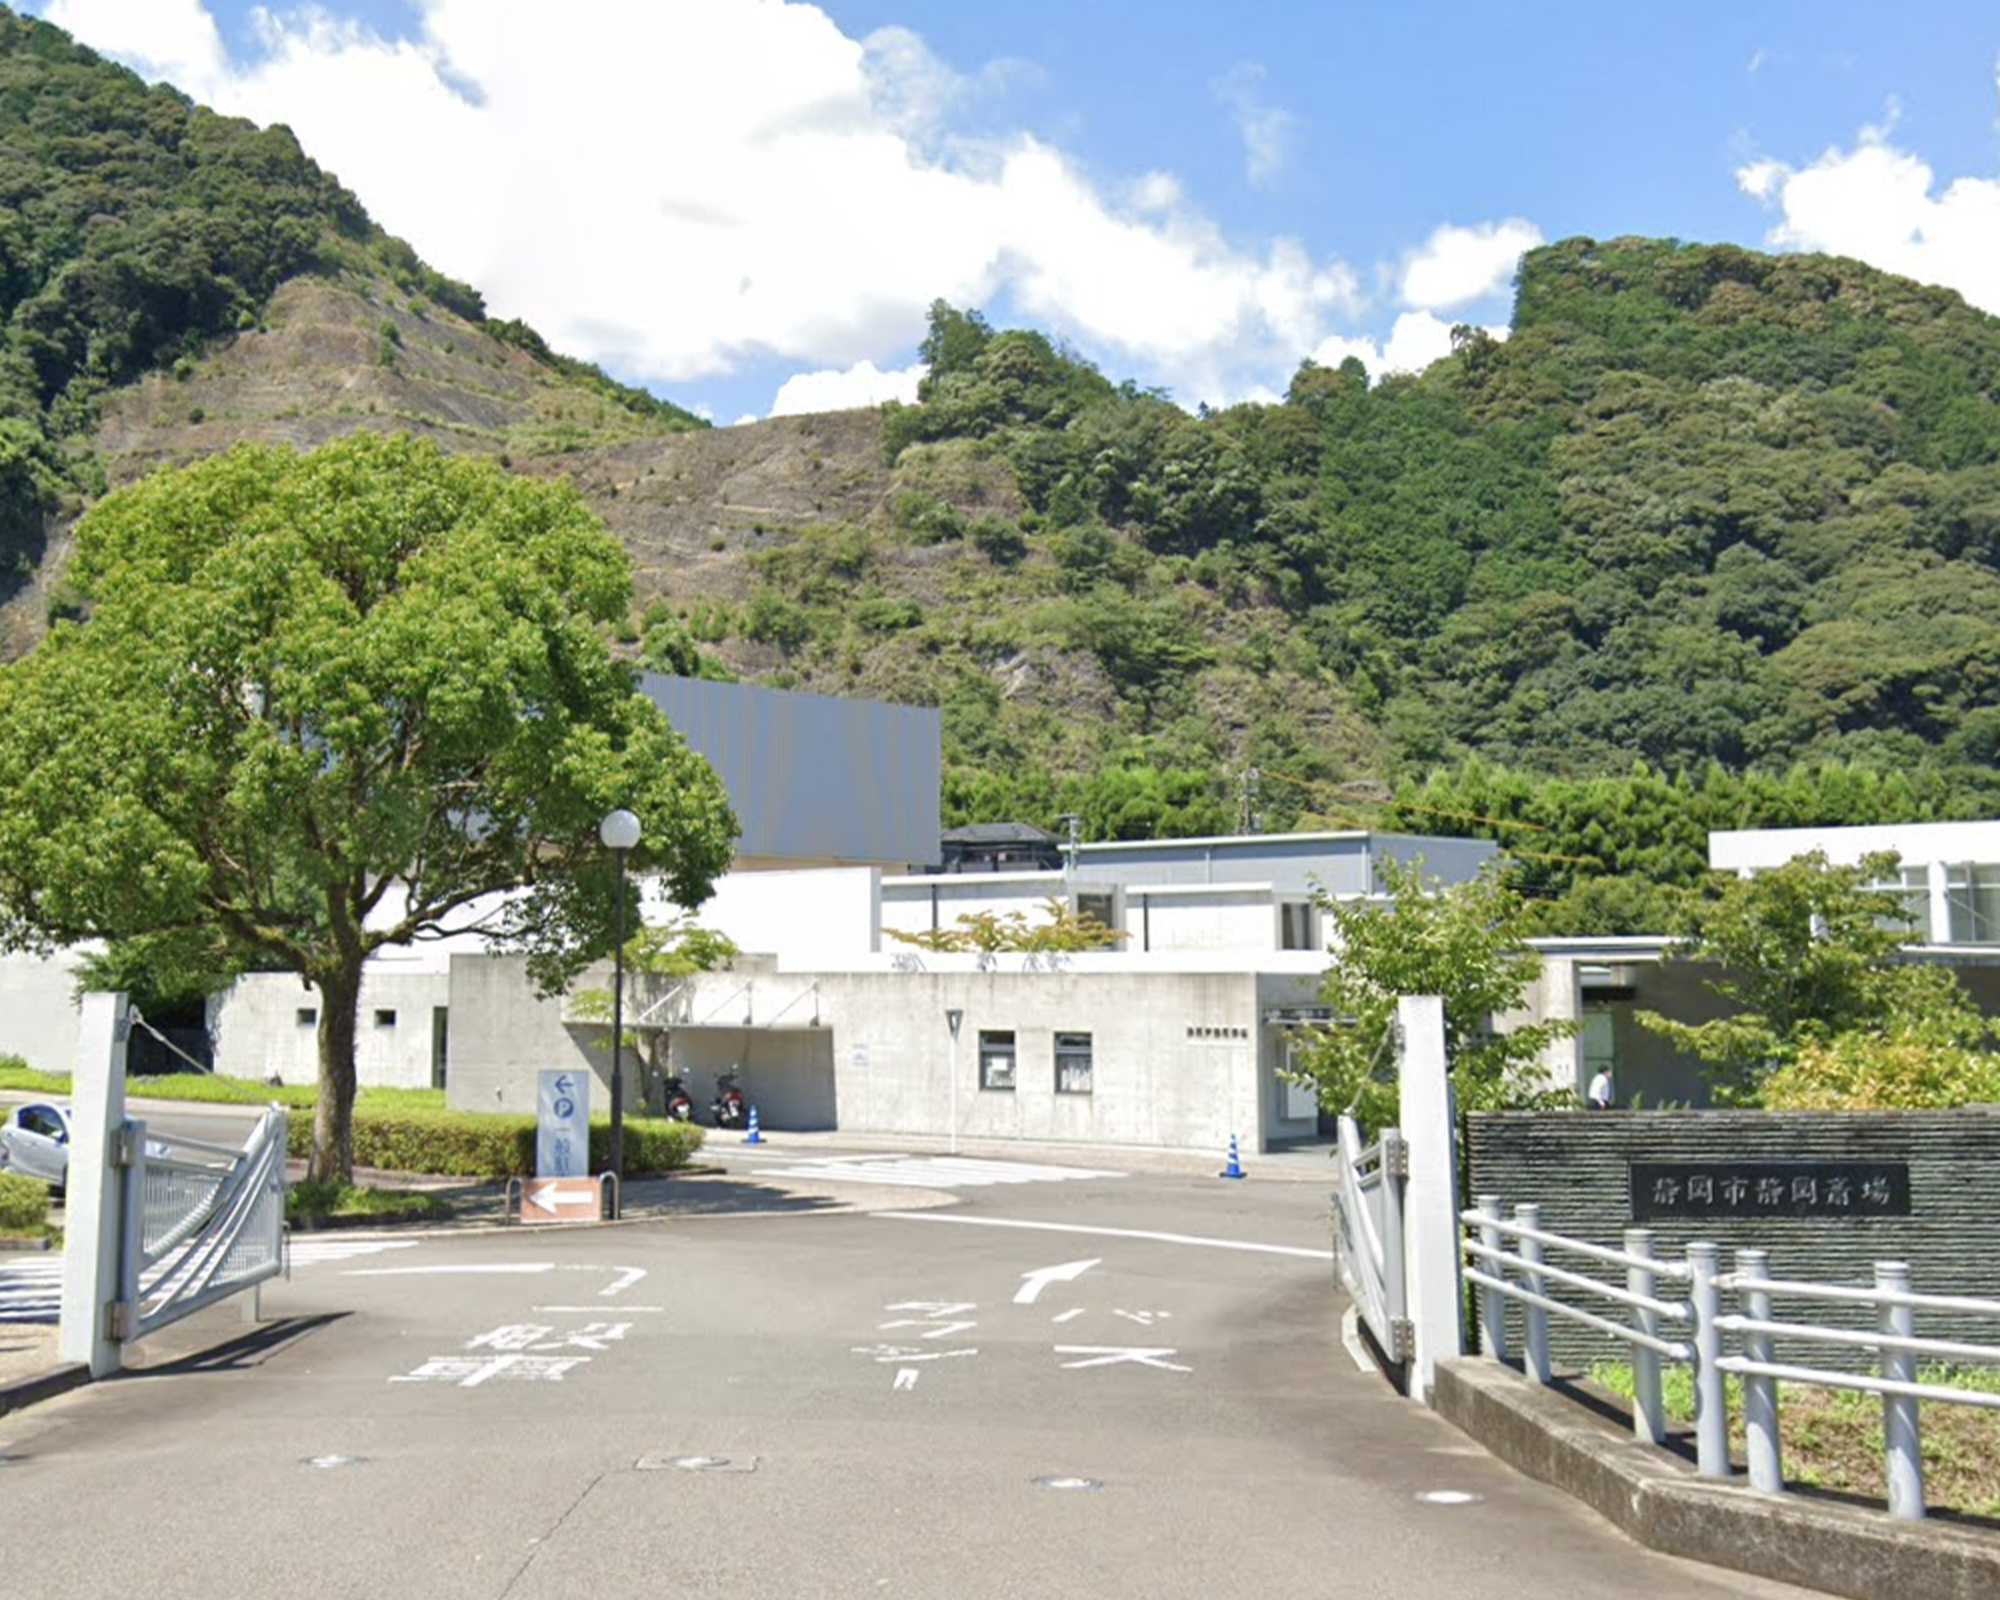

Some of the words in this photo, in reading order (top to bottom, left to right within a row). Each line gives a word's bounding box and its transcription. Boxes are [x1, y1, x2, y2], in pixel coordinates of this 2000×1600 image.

[556, 1099, 573, 1118] P
[388, 1306, 664, 1387] 一般車
[851, 1301, 978, 1391] タクシー
[1051, 1307, 1194, 1372] バス
